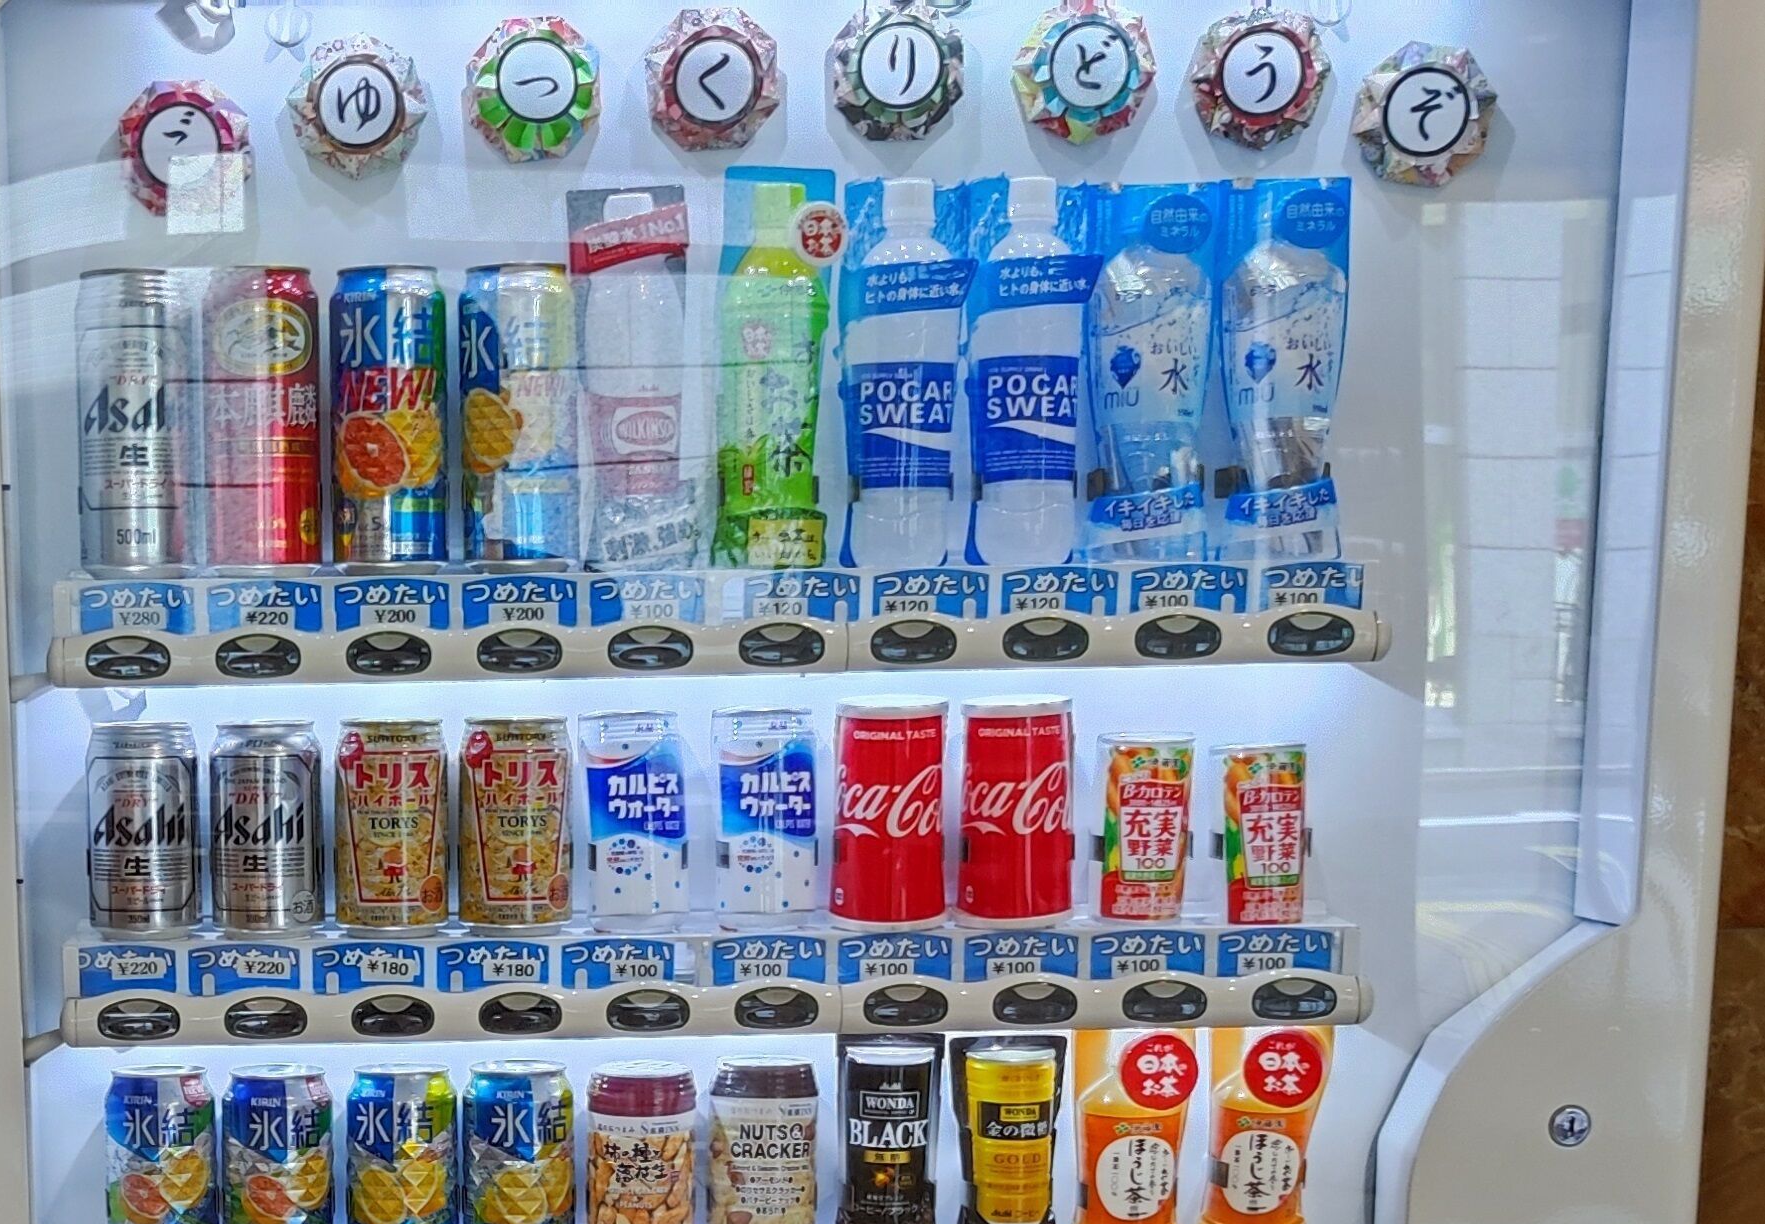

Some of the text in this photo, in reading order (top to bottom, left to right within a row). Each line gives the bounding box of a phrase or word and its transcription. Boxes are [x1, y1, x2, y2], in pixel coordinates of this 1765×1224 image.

[339, 306, 435, 368] 氷結
[120, 446, 149, 467] 生
[116, 527, 157, 545] 500ml
[593, 578, 704, 601] つめたい
[748, 574, 859, 598] つめたい
[876, 572, 988, 596] つめたい
[1006, 569, 1118, 593] つめたい
[1135, 568, 1245, 591] つめたい
[82, 584, 193, 609] つめたい
[209, 583, 320, 607] つめたい
[337, 580, 447, 604] つめたい
[465, 579, 575, 603] つめたい
[1145, 593, 1189, 608] ¥100
[630, 602, 674, 619] ¥100
[758, 601, 803, 617] ¥120
[885, 599, 929, 612] ¥120
[1016, 596, 1060, 610] ¥120
[119, 609, 161, 626] ¥280
[246, 609, 289, 625] ¥220
[374, 607, 416, 623] ¥200
[502, 606, 545, 622] ¥200
[353, 760, 431, 790] トリス
[482, 760, 559, 790] トリス
[607, 772, 679, 797] カルピス
[740, 771, 813, 795] カルピス
[357, 794, 430, 807] ハイボール
[484, 793, 559, 807] ハイボール
[93, 803, 186, 847] Asahi
[215, 801, 305, 847] Asahi
[368, 816, 419, 829] TORYS
[497, 815, 547, 828] TORYS
[1123, 809, 1179, 838] 充実
[1247, 813, 1299, 844] 充実
[124, 855, 151, 877] 生
[242, 854, 269, 873] 生
[1259, 861, 1291, 874] 100
[716, 940, 823, 961] つめたい
[841, 937, 949, 958] つめたい
[968, 935, 1076, 957] つめたい
[1093, 933, 1203, 955] つめたい
[1220, 931, 1329, 953] つめたい
[565, 943, 672, 963] つめたい
[1242, 955, 1286, 971] ¥100
[117, 961, 158, 975] ¥220
[244, 960, 285, 975] ¥220
[367, 961, 409, 977] ¥180
[492, 963, 535, 977] ¥180
[615, 963, 658, 978] ¥100
[740, 962, 782, 977] ¥100
[865, 958, 908, 975] ¥100
[993, 959, 1036, 974] ¥100
[1117, 957, 1160, 973] ¥100
[250, 1097, 282, 1107] KIRIN
[865, 1095, 915, 1111] WONDA
[122, 1108, 195, 1148] 氷結
[248, 1109, 321, 1150] 氷結
[356, 1101, 435, 1146] 氷結
[491, 1101, 567, 1147] 氷結
[849, 1117, 930, 1149] BLACK
[730, 1142, 811, 1160] CRACKER
[993, 1152, 1042, 1165] GOLD
